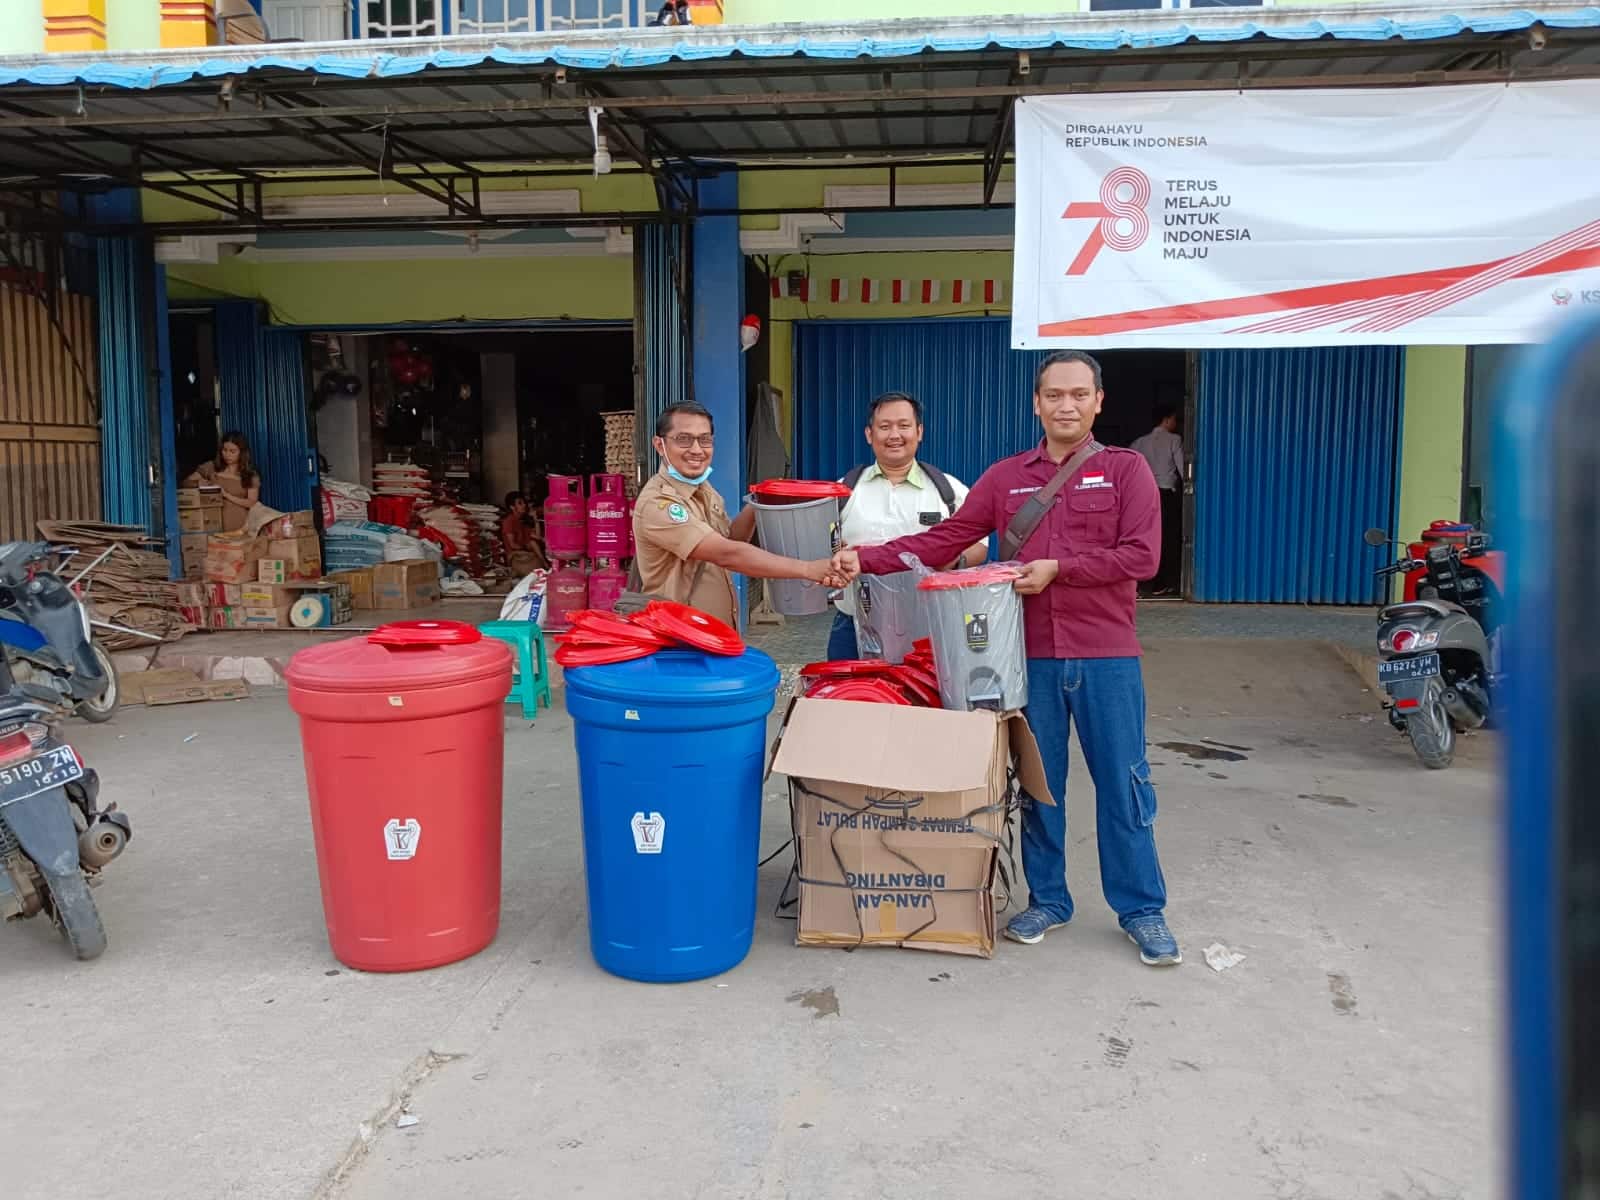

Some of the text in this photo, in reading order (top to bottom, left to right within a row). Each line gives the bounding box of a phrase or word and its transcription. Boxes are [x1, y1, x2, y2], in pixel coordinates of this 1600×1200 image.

[1065, 124, 1143, 135] DIRGAHAYU
[1065, 136, 1208, 148] REPUBLIK INDONESIA
[1165, 180, 1218, 192] TERUS
[1164, 195, 1232, 209] MELAJU
[1061, 166, 1150, 275] 78
[1164, 213, 1220, 226] UNTUK
[1163, 229, 1252, 243] INDONESIA
[1163, 247, 1209, 259] MAJU
[0, 760, 42, 784] 5190
[817, 811, 858, 829] BULAT
[846, 872, 945, 888] DIBANTING
[857, 893, 931, 909] JANGAN
